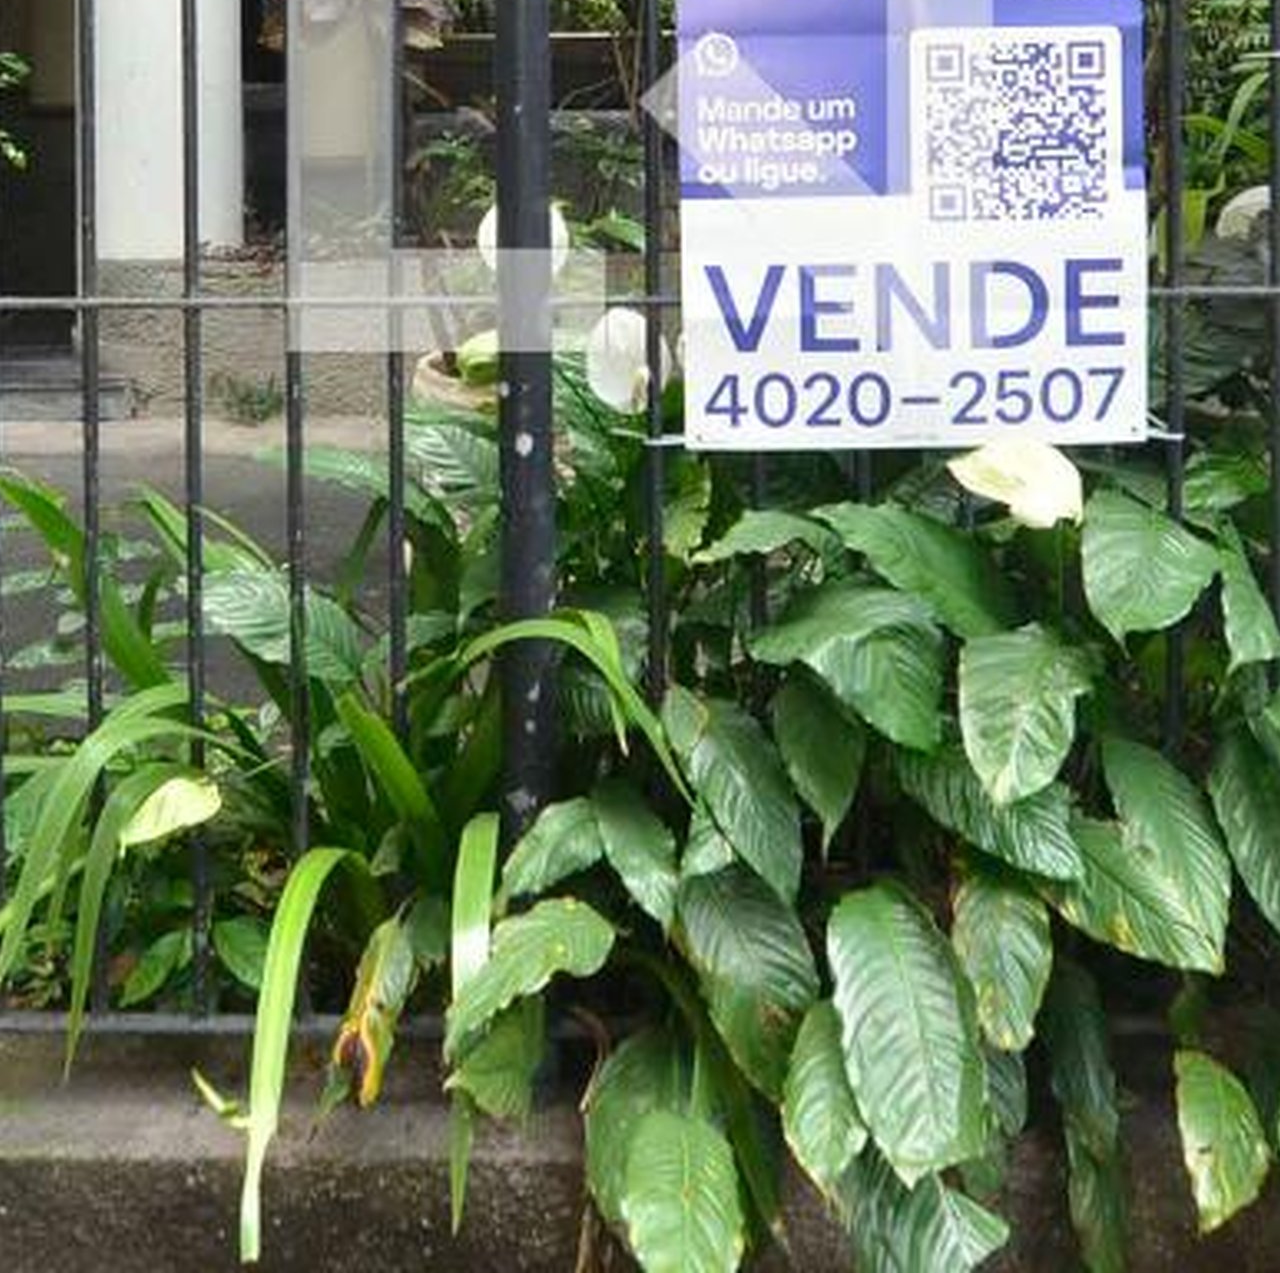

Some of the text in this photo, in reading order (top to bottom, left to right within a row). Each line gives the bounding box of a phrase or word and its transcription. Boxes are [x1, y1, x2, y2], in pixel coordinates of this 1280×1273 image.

[696, 96, 856, 122] Mande um
[696, 163, 738, 184] ou
[703, 258, 1126, 353] VENDE
[704, 367, 1126, 428] 4020-2507
